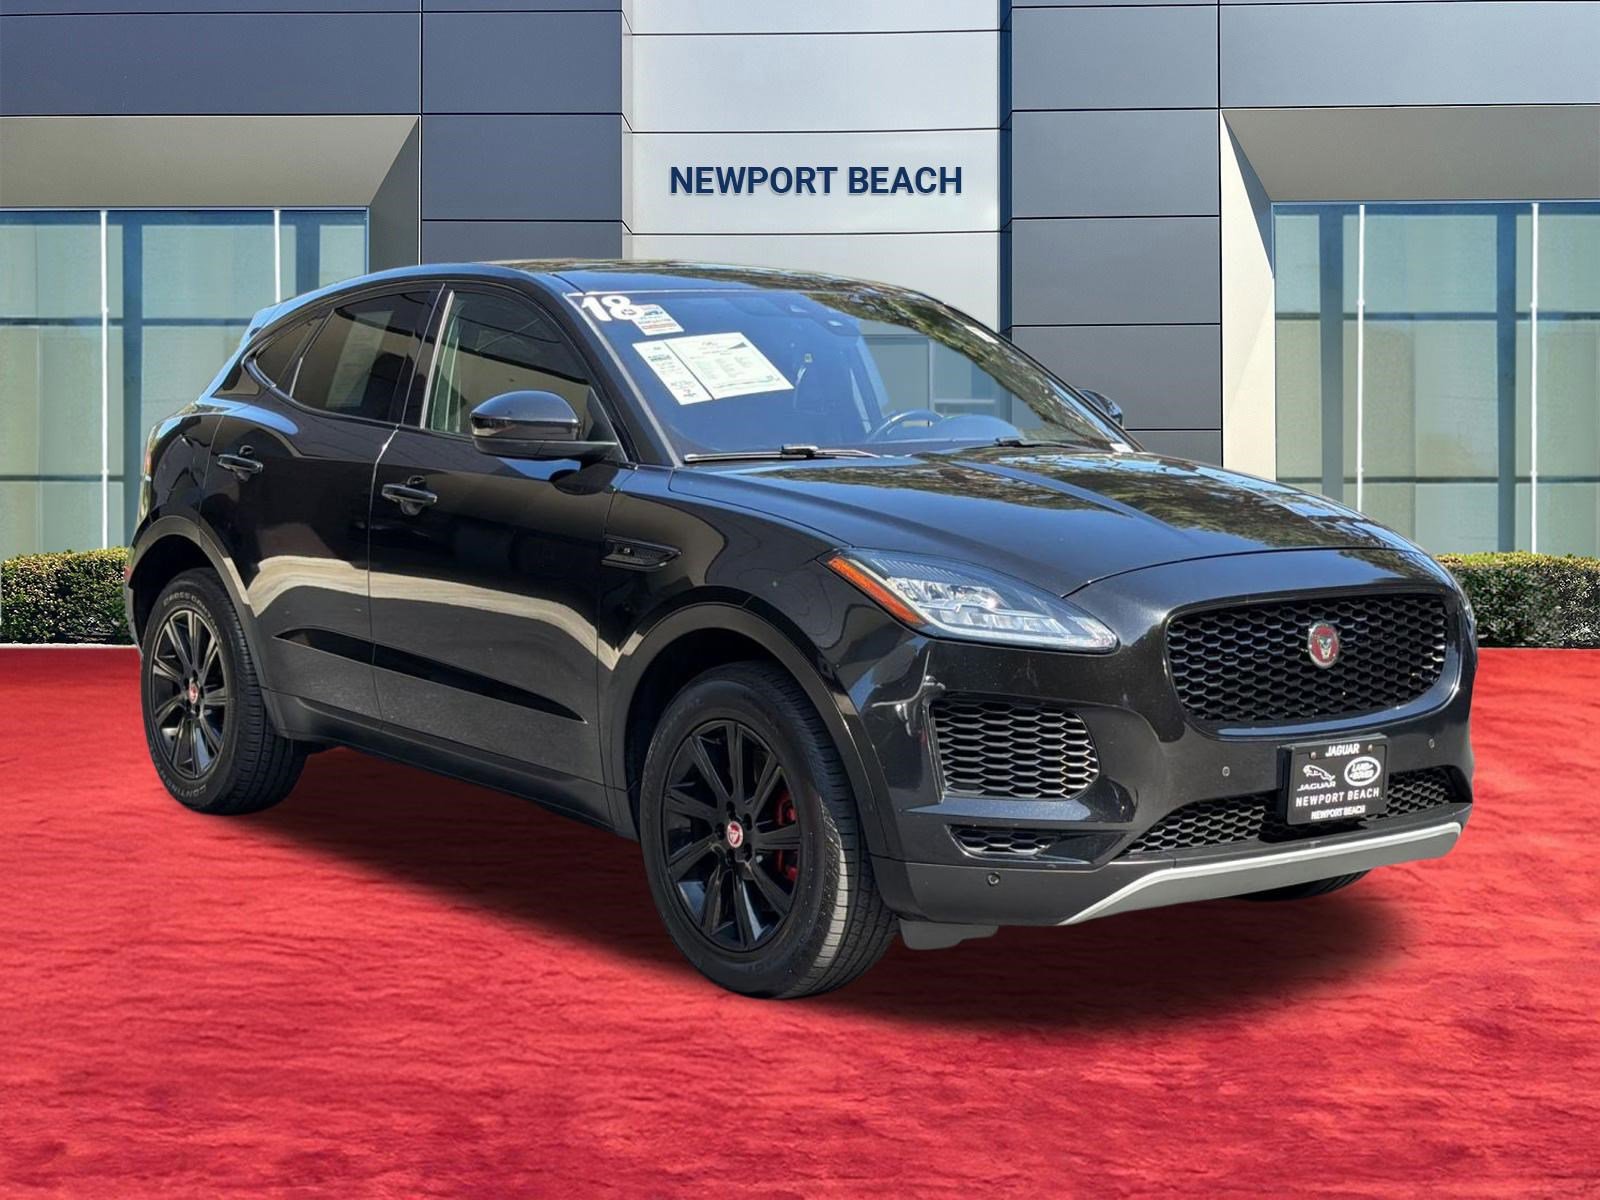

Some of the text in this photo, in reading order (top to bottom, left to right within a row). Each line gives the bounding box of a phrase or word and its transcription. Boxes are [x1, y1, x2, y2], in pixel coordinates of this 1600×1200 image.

[670, 166, 962, 194] NEWPORT BEACH
[581, 295, 643, 322] 18
[1325, 743, 1360, 757] JAGUAR
[1297, 781, 1336, 791] JAGUAR
[1295, 787, 1380, 807] NEWPORT BEACH
[1311, 805, 1366, 820] NEWPORT BEACH
